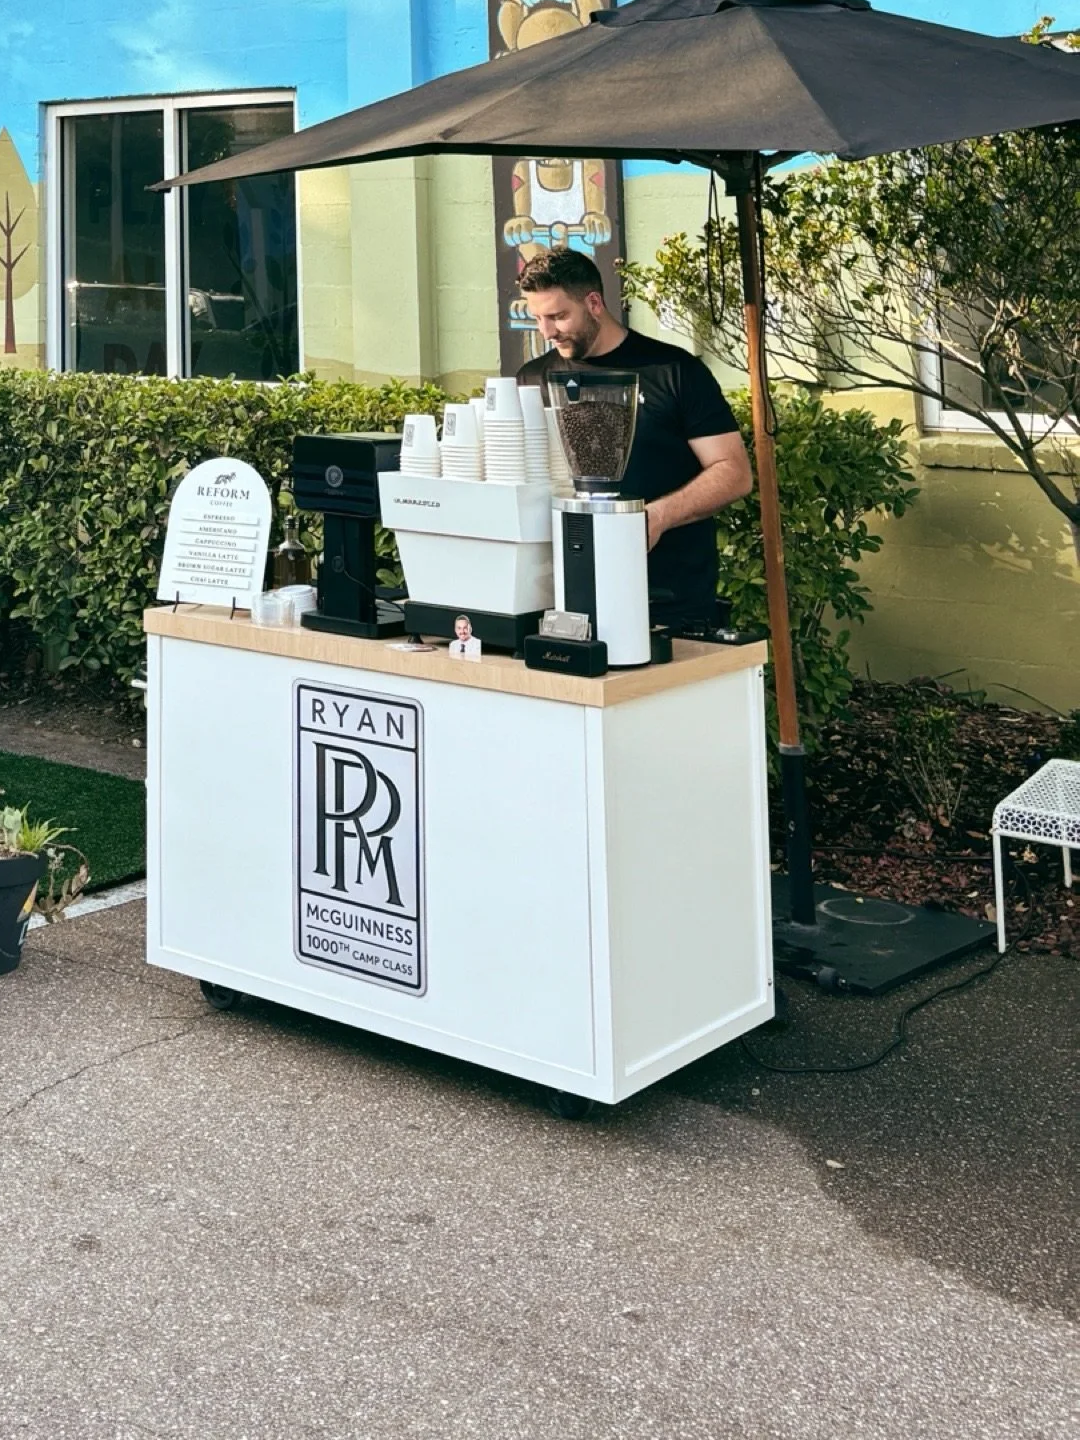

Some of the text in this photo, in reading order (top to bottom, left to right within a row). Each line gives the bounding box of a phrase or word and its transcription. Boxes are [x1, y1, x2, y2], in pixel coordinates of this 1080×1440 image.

[196, 485, 250, 500] REFORM
[198, 526, 238, 535] AMERICANO
[194, 537, 237, 548] CAPPUCCINO
[188, 550, 239, 561] VANILLA LATTE
[177, 561, 201, 570] BROWN
[225, 566, 246, 574] LATTE
[207, 578, 229, 586] LATTE
[311, 698, 405, 740] RYAN
[351, 950, 380, 966] CAMP
[382, 959, 413, 976] CLASS
